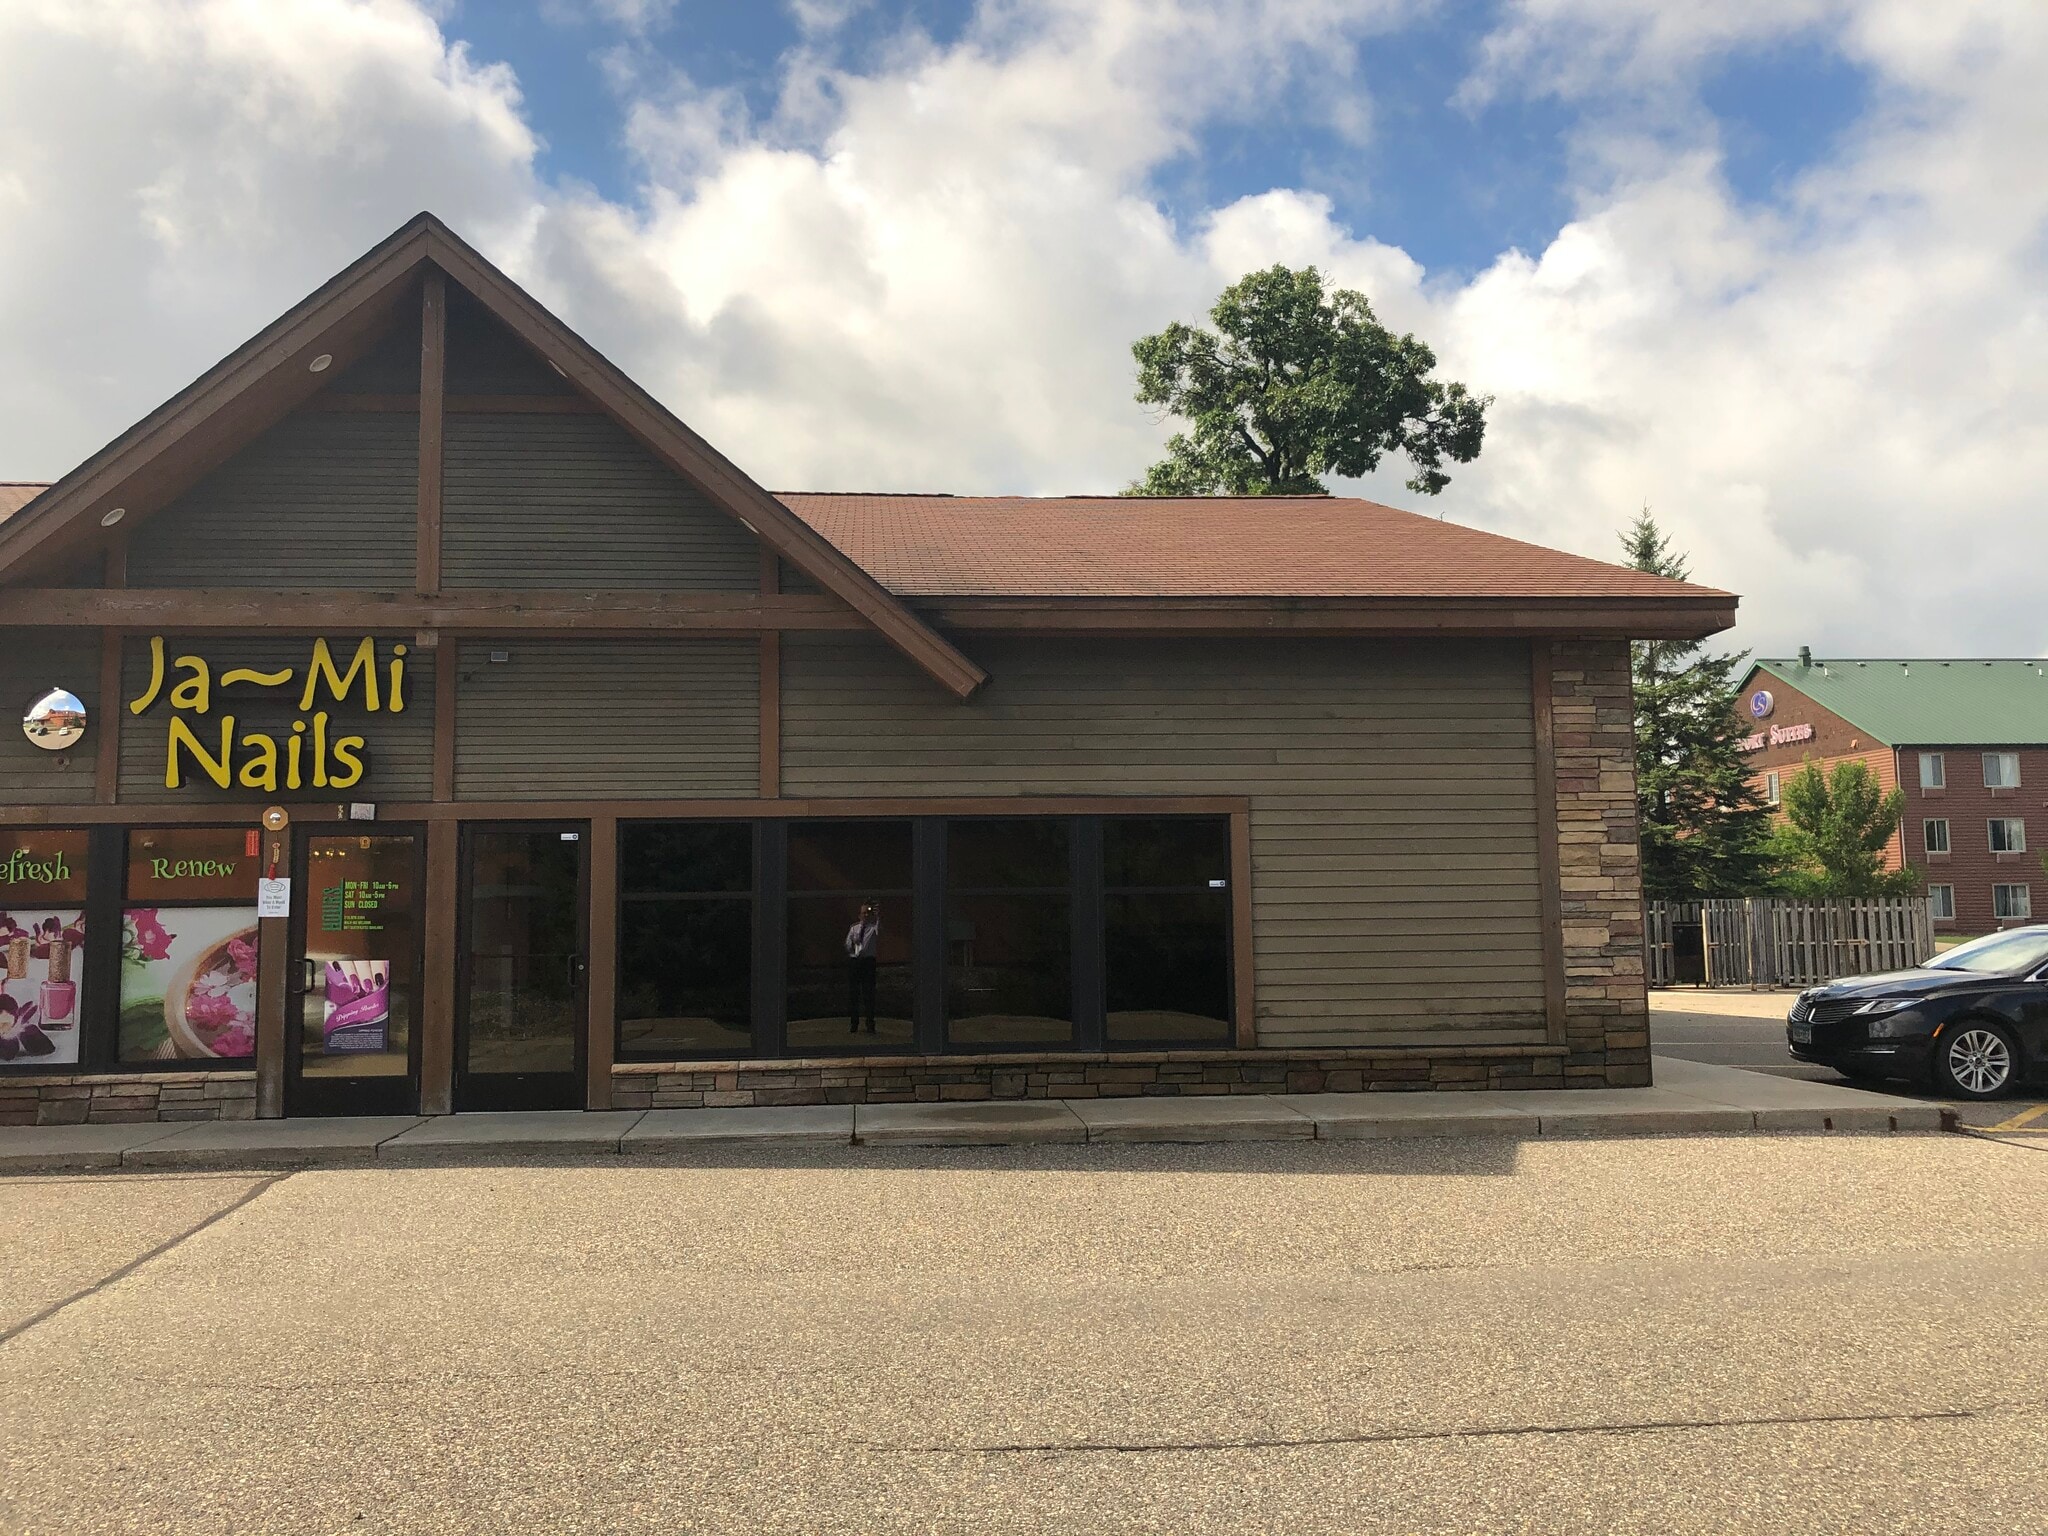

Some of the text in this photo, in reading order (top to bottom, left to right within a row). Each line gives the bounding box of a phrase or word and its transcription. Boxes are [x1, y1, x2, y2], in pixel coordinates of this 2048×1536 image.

[165, 711, 365, 792] Nails
[0, 848, 71, 885] efresh
[151, 857, 237, 880] Renew
[344, 890, 355, 899] SAT
[344, 900, 378, 909] SUN CLOSED
